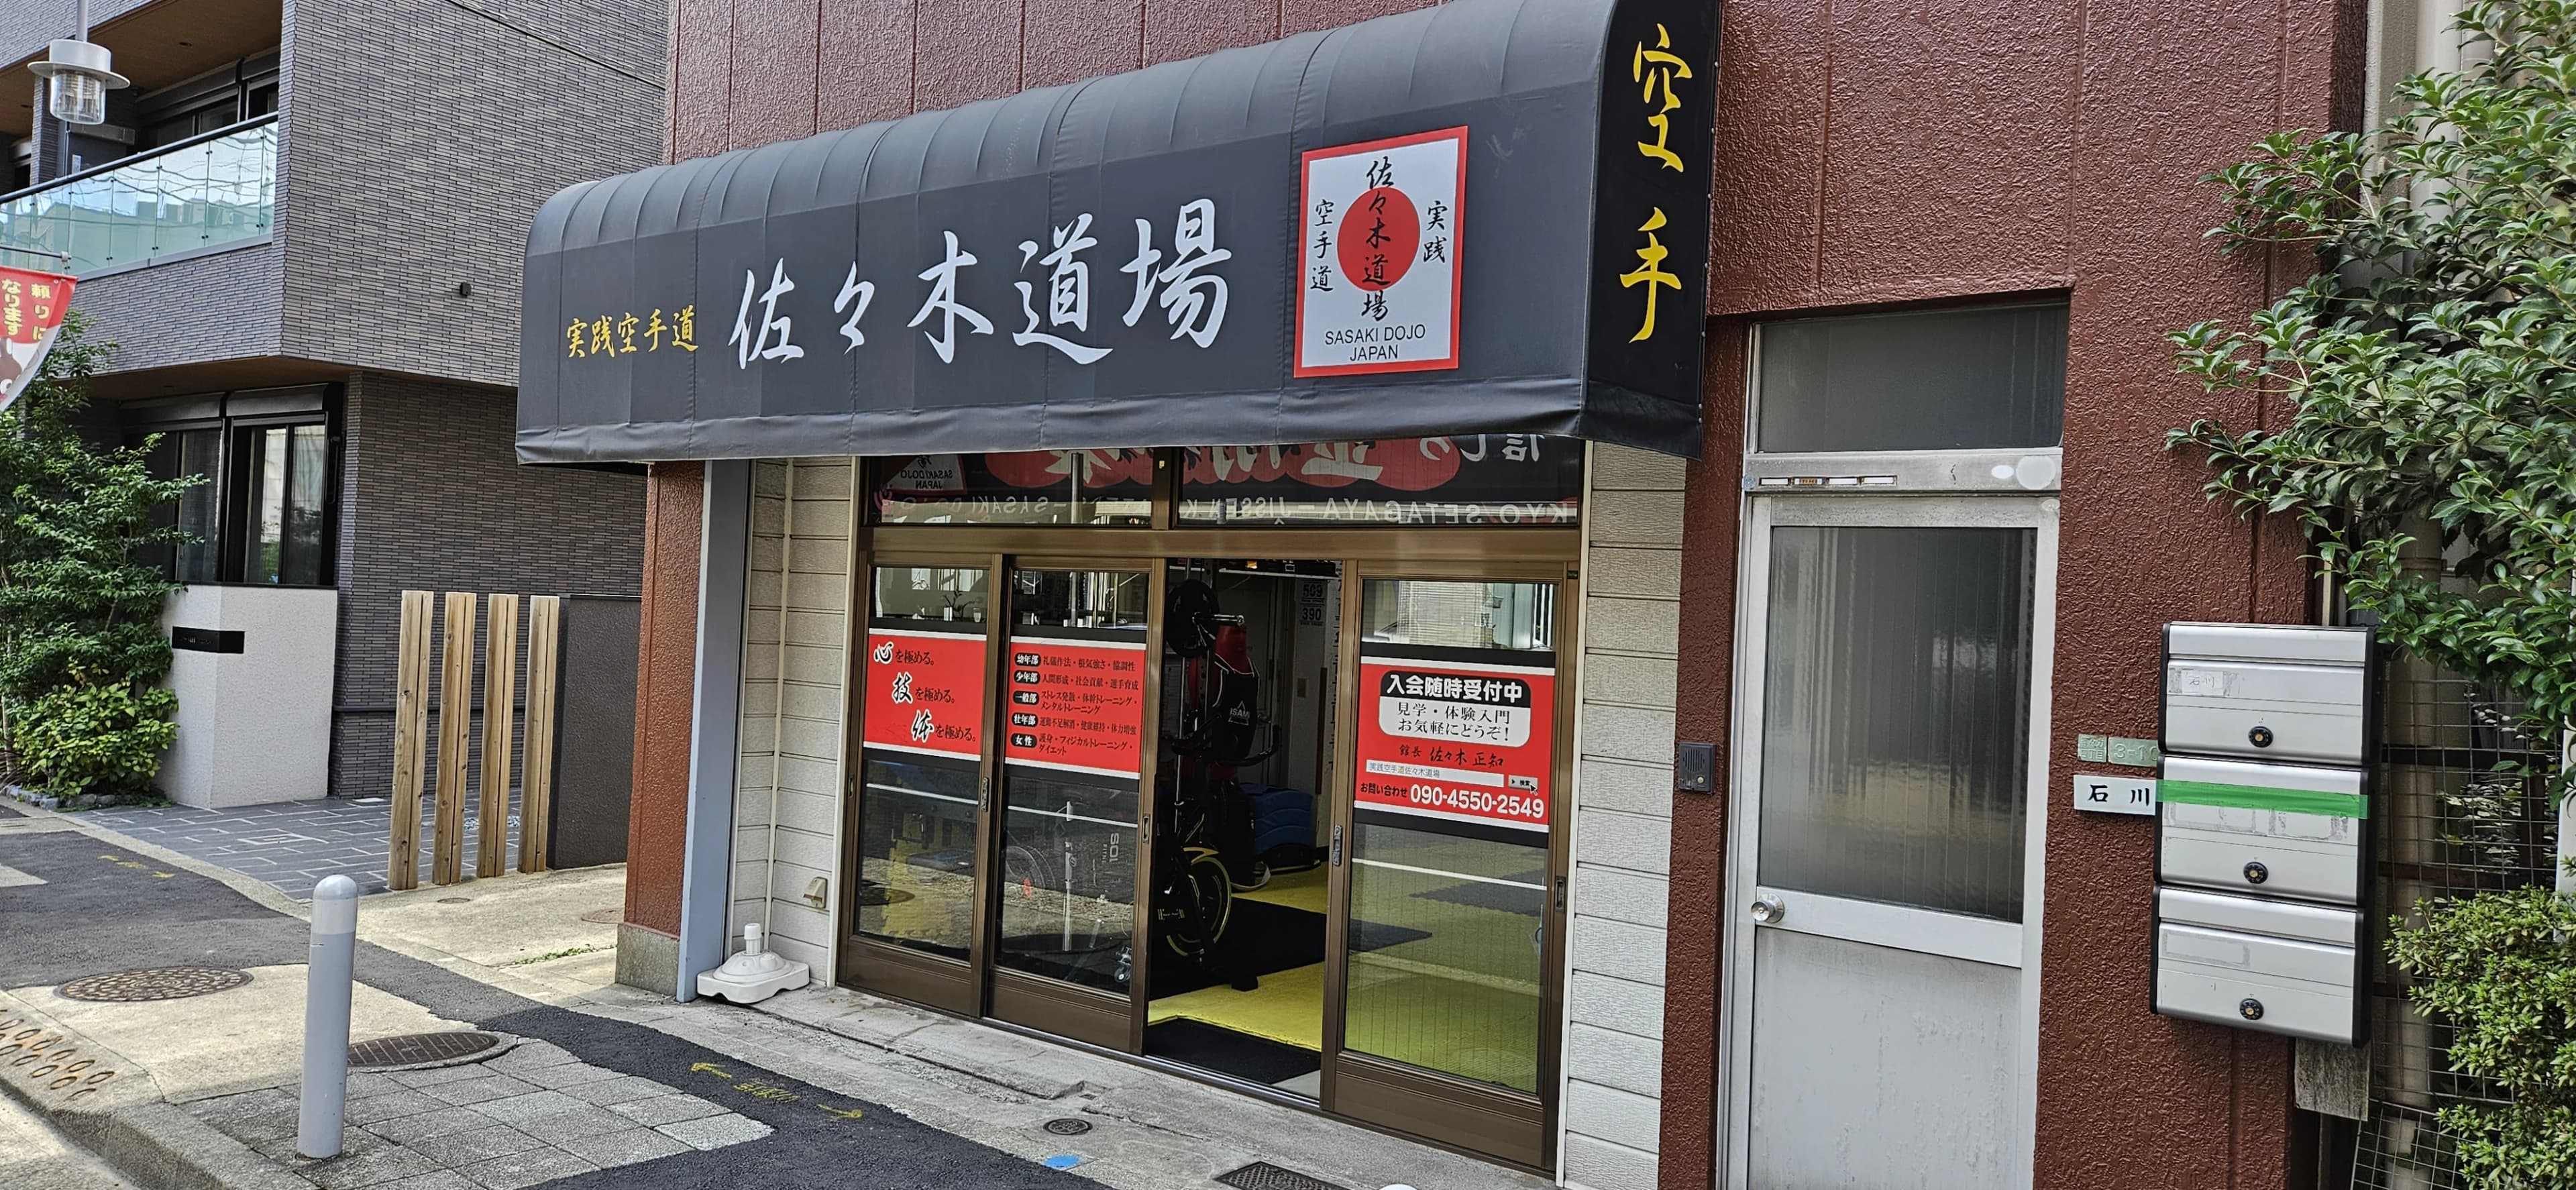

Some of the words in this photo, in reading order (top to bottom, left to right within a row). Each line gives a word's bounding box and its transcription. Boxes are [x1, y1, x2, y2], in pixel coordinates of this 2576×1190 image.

[1619, 23, 1693, 343] 空手
[1309, 199, 1335, 292] 空手道
[1360, 156, 1395, 322] 佐々木道場
[1423, 201, 1448, 264] 実践
[727, 197, 1233, 370] 佐々木道場
[1, 278, 23, 335] なります
[31, 283, 51, 340] 頼りに
[566, 305, 700, 359] 実践空手道
[1324, 327, 1379, 345] SASAKI
[1384, 324, 1426, 341] DOJO
[1349, 344, 1399, 362] JAPAN
[873, 641, 934, 665] 心を極める。
[892, 671, 955, 704] 技を極める。
[1016, 671, 1038, 684] 少年部
[1386, 673, 1523, 704] 入会随時受付中
[1397, 701, 1511, 724] 見学・体験入門
[1015, 735, 1033, 747] 女性
[1398, 718, 1510, 741] お気軽にどうぞ!
[1430, 746, 1468, 766] 佐々木
[1360, 781, 1408, 798] お問い合わせ
[1410, 784, 1544, 818] 090-4550-2549
[2087, 784, 2150, 807] 石川
